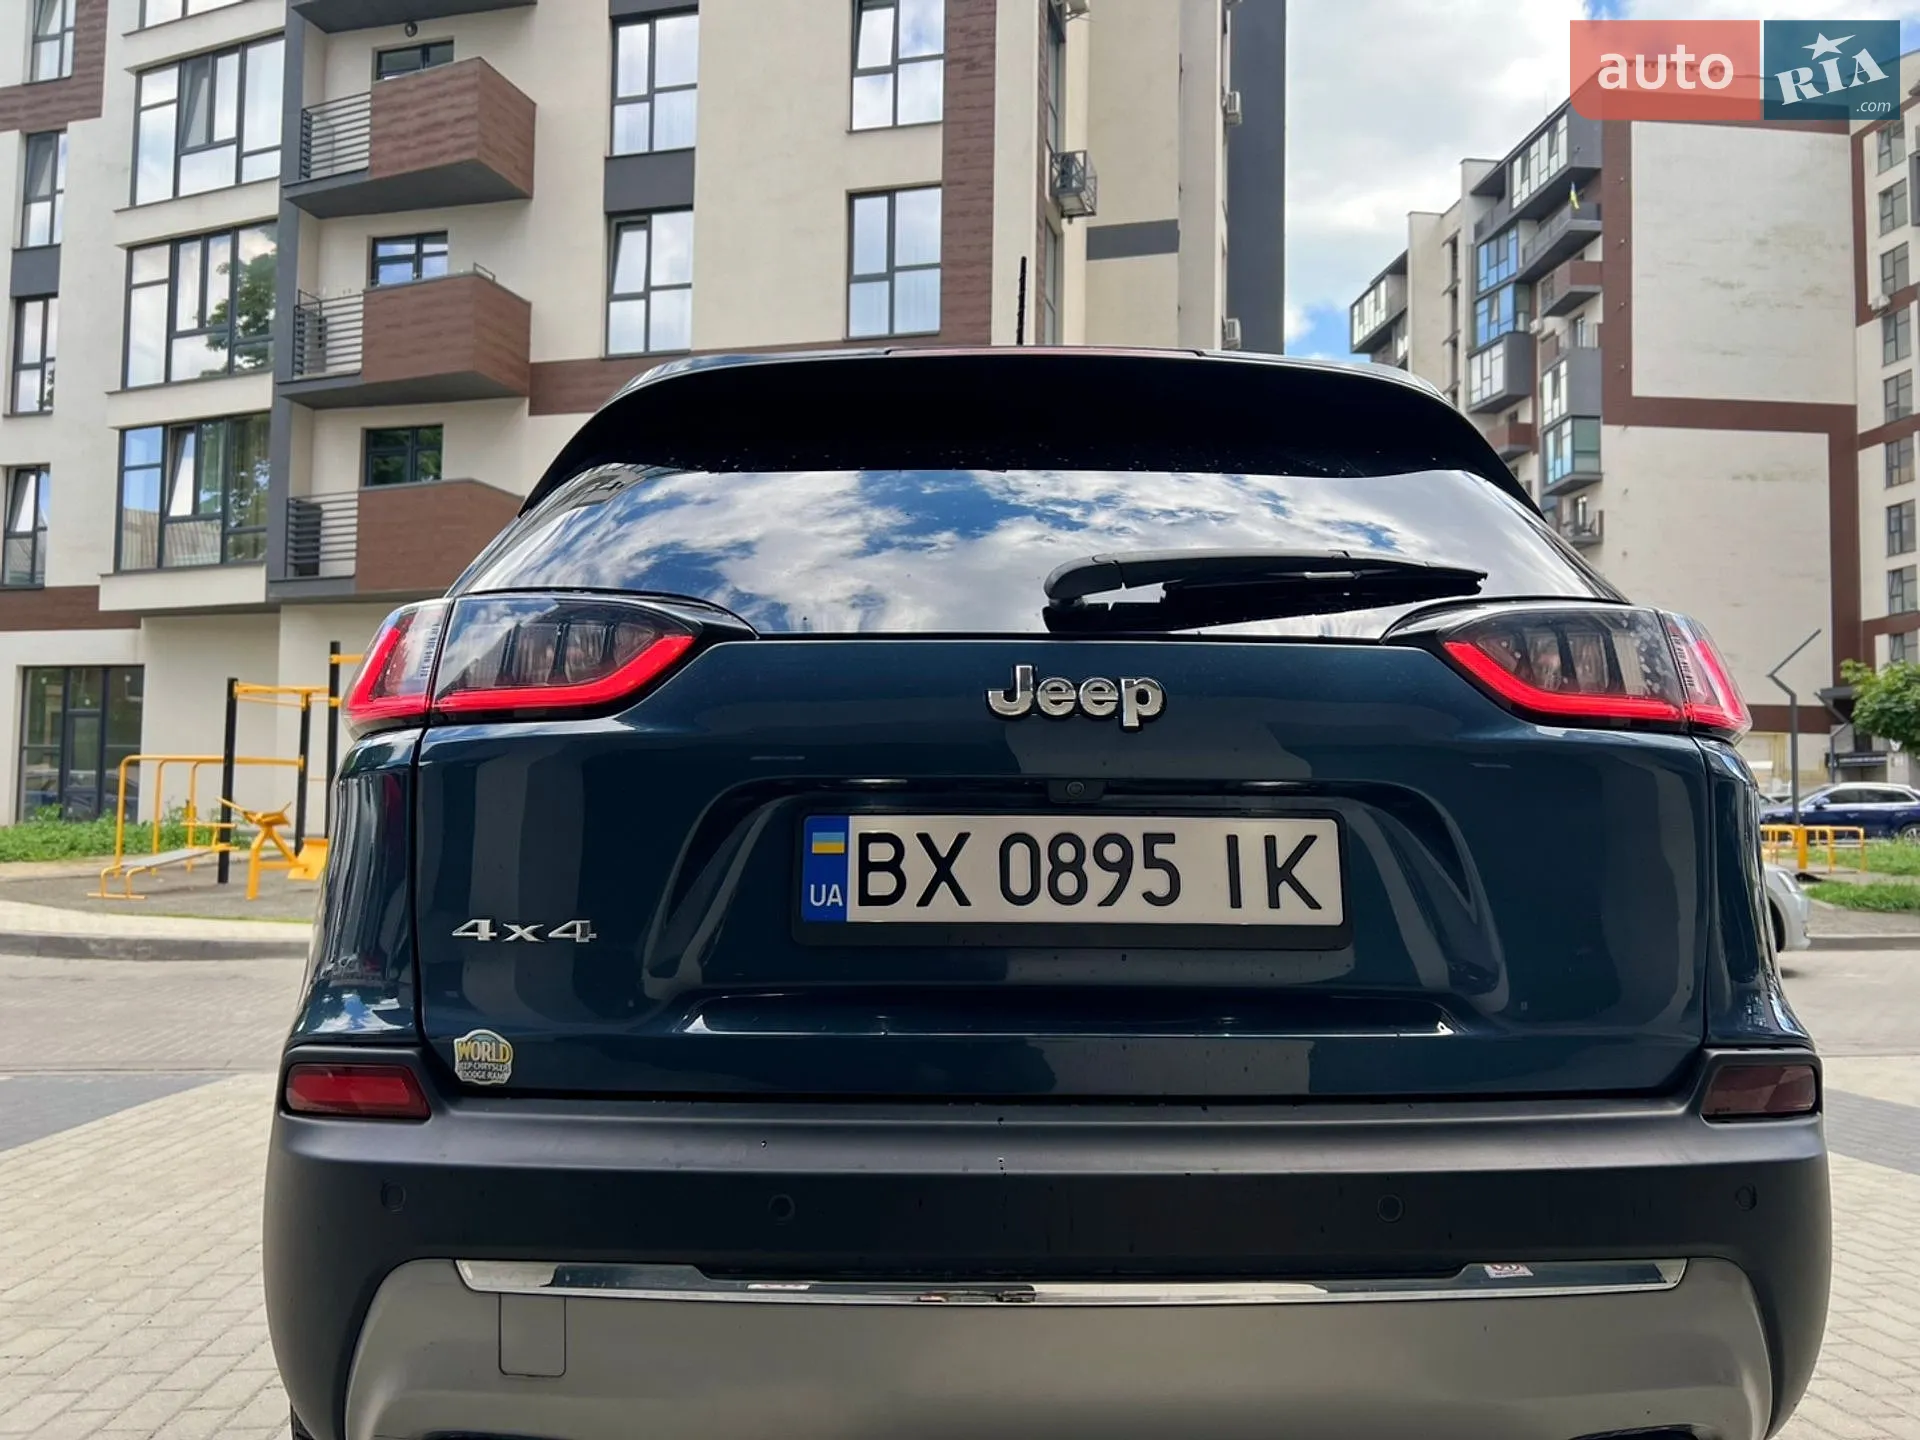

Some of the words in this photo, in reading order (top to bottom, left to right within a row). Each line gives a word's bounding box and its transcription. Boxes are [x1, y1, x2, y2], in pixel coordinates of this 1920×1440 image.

[987, 664, 1164, 729] Jeep
[857, 832, 971, 907] BX
[999, 832, 1181, 907] 0895
[1226, 834, 1322, 910] IK
[810, 884, 843, 907] UA
[451, 918, 597, 943] 4x4
[457, 1040, 510, 1063] WORLD
